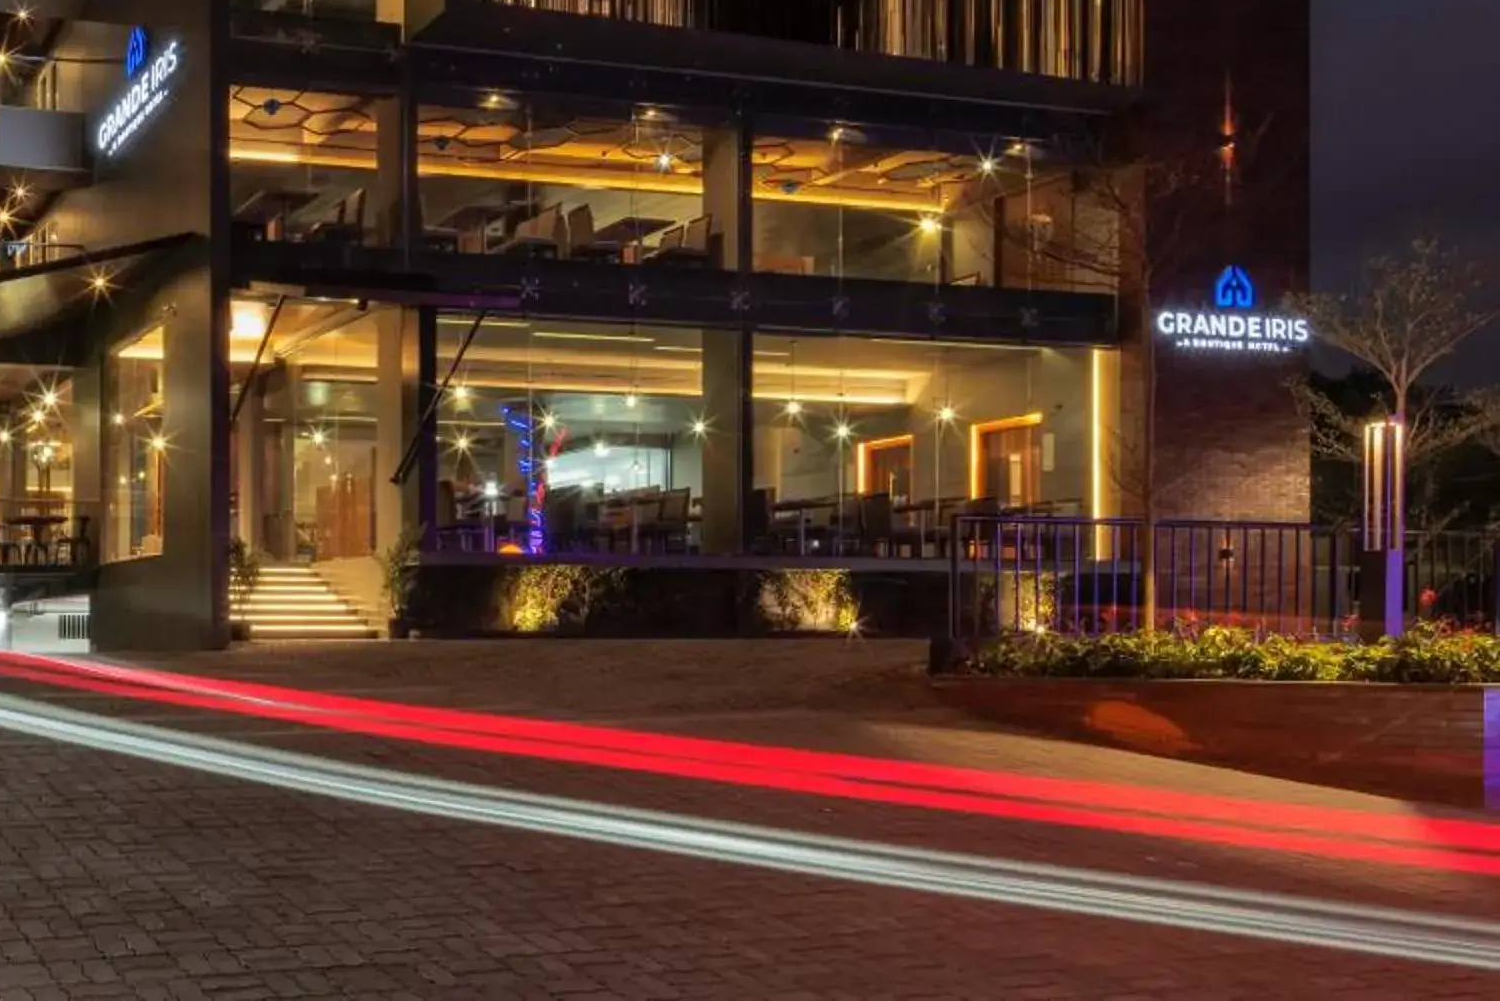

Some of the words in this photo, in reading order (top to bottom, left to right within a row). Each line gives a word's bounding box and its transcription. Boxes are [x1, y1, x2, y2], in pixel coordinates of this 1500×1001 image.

[98, 71, 149, 149] GRANDE
[151, 41, 178, 91] IRIS
[1157, 310, 1262, 338] GRANDE
[1265, 317, 1309, 342] IRIS
